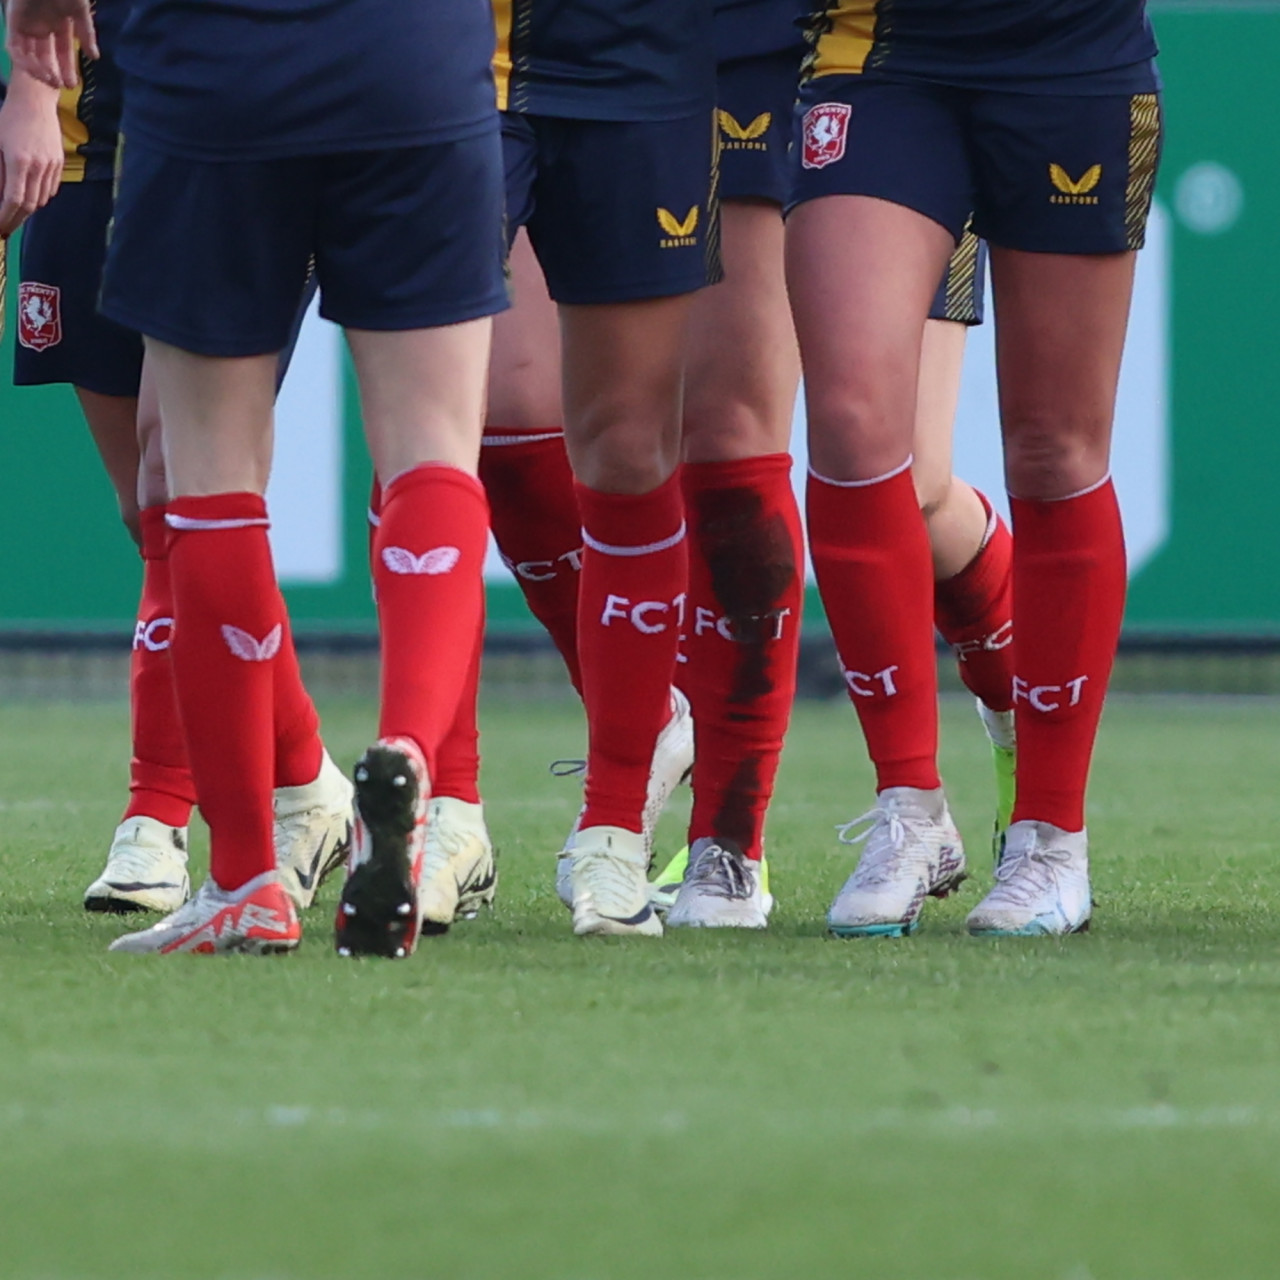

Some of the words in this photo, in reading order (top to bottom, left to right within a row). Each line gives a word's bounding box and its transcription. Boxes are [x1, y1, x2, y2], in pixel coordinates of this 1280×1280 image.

[508, 549, 583, 581] CT
[601, 592, 687, 634] FCT
[133, 618, 174, 651] FC
[952, 619, 1013, 661] FC
[836, 665, 899, 697] CT
[1012, 675, 1089, 712] FCT
